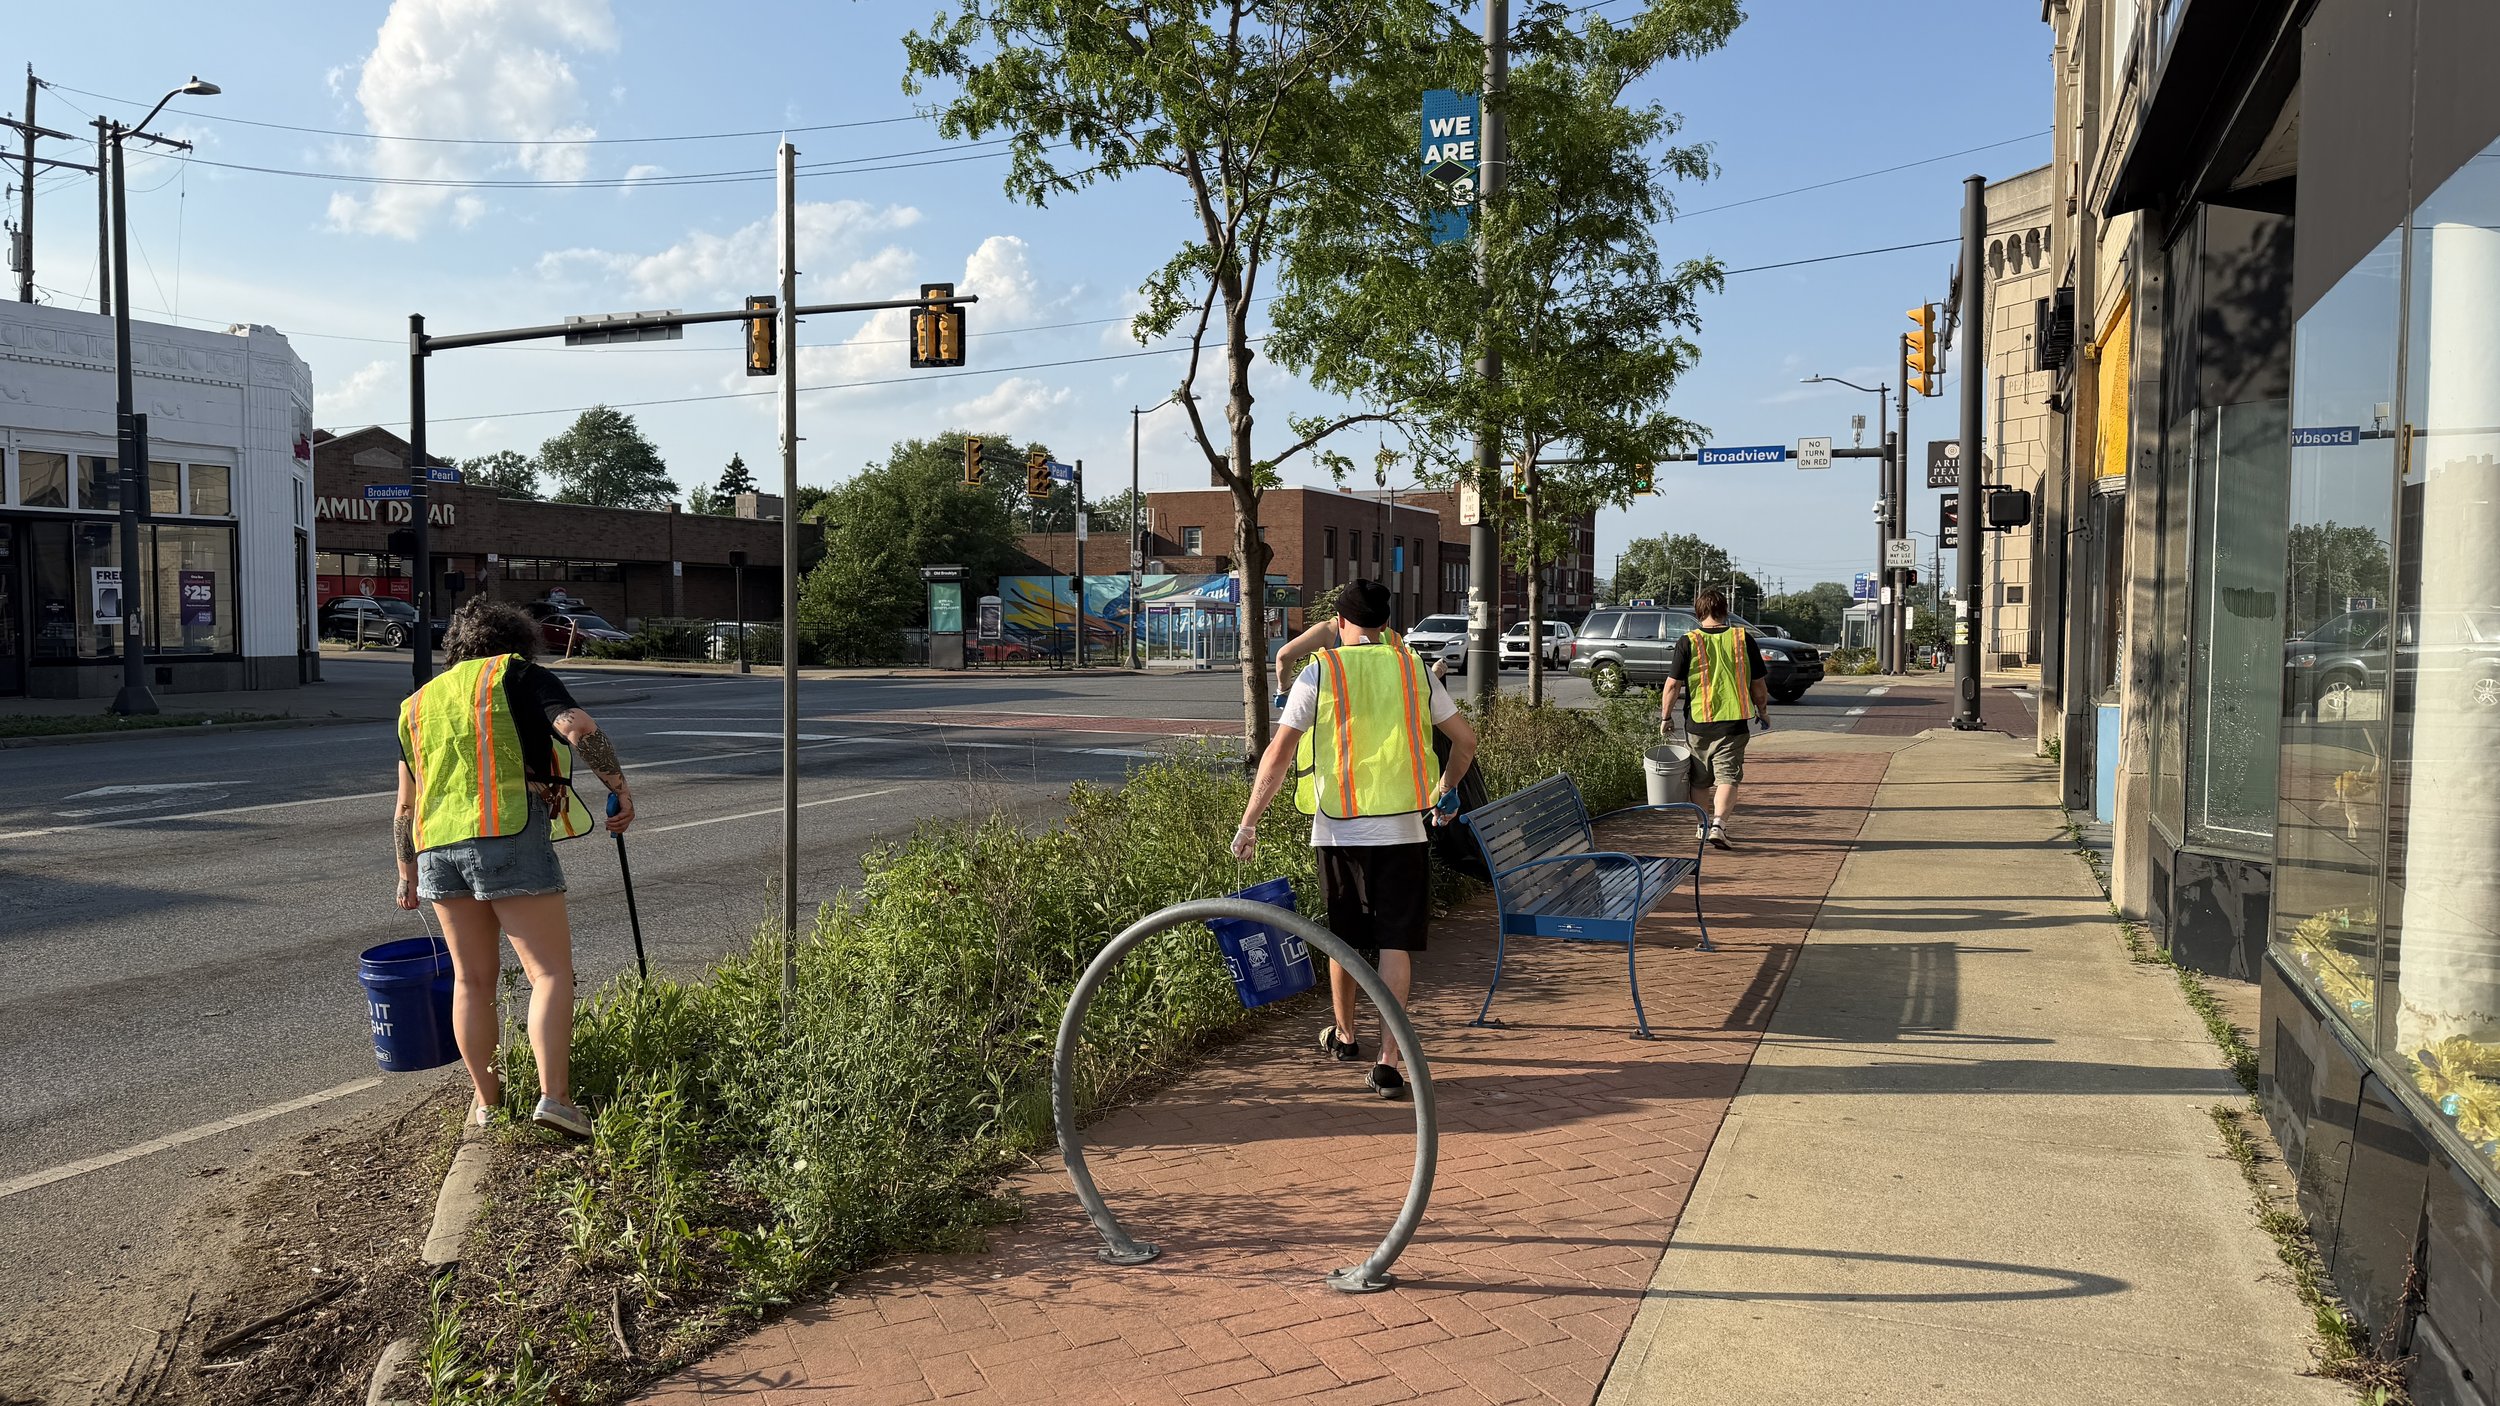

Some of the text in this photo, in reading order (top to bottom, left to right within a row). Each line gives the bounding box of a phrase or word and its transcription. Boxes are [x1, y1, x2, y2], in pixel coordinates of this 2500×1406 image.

[1429, 115, 1471, 138] WE
[1424, 140, 1475, 164] ARE
[2009, 376, 2038, 392] PEAL
[1703, 449, 1779, 463] Broadview
[1813, 458, 1828, 466] RED
[1934, 459, 1960, 467] ARI
[431, 469, 454, 481] Pearl
[1051, 466, 1068, 478] Pearl
[1933, 467, 1960, 475] PEA
[1929, 475, 1959, 484] CENT
[367, 486, 410, 497] Broadview
[314, 496, 455, 525] AMILY DOAR
[1945, 537, 1958, 545] GR
[1133, 553, 1142, 563] 42
[184, 585, 212, 600] $25
[374, 1002, 391, 1020] IT
[371, 1020, 394, 1037] GHT
